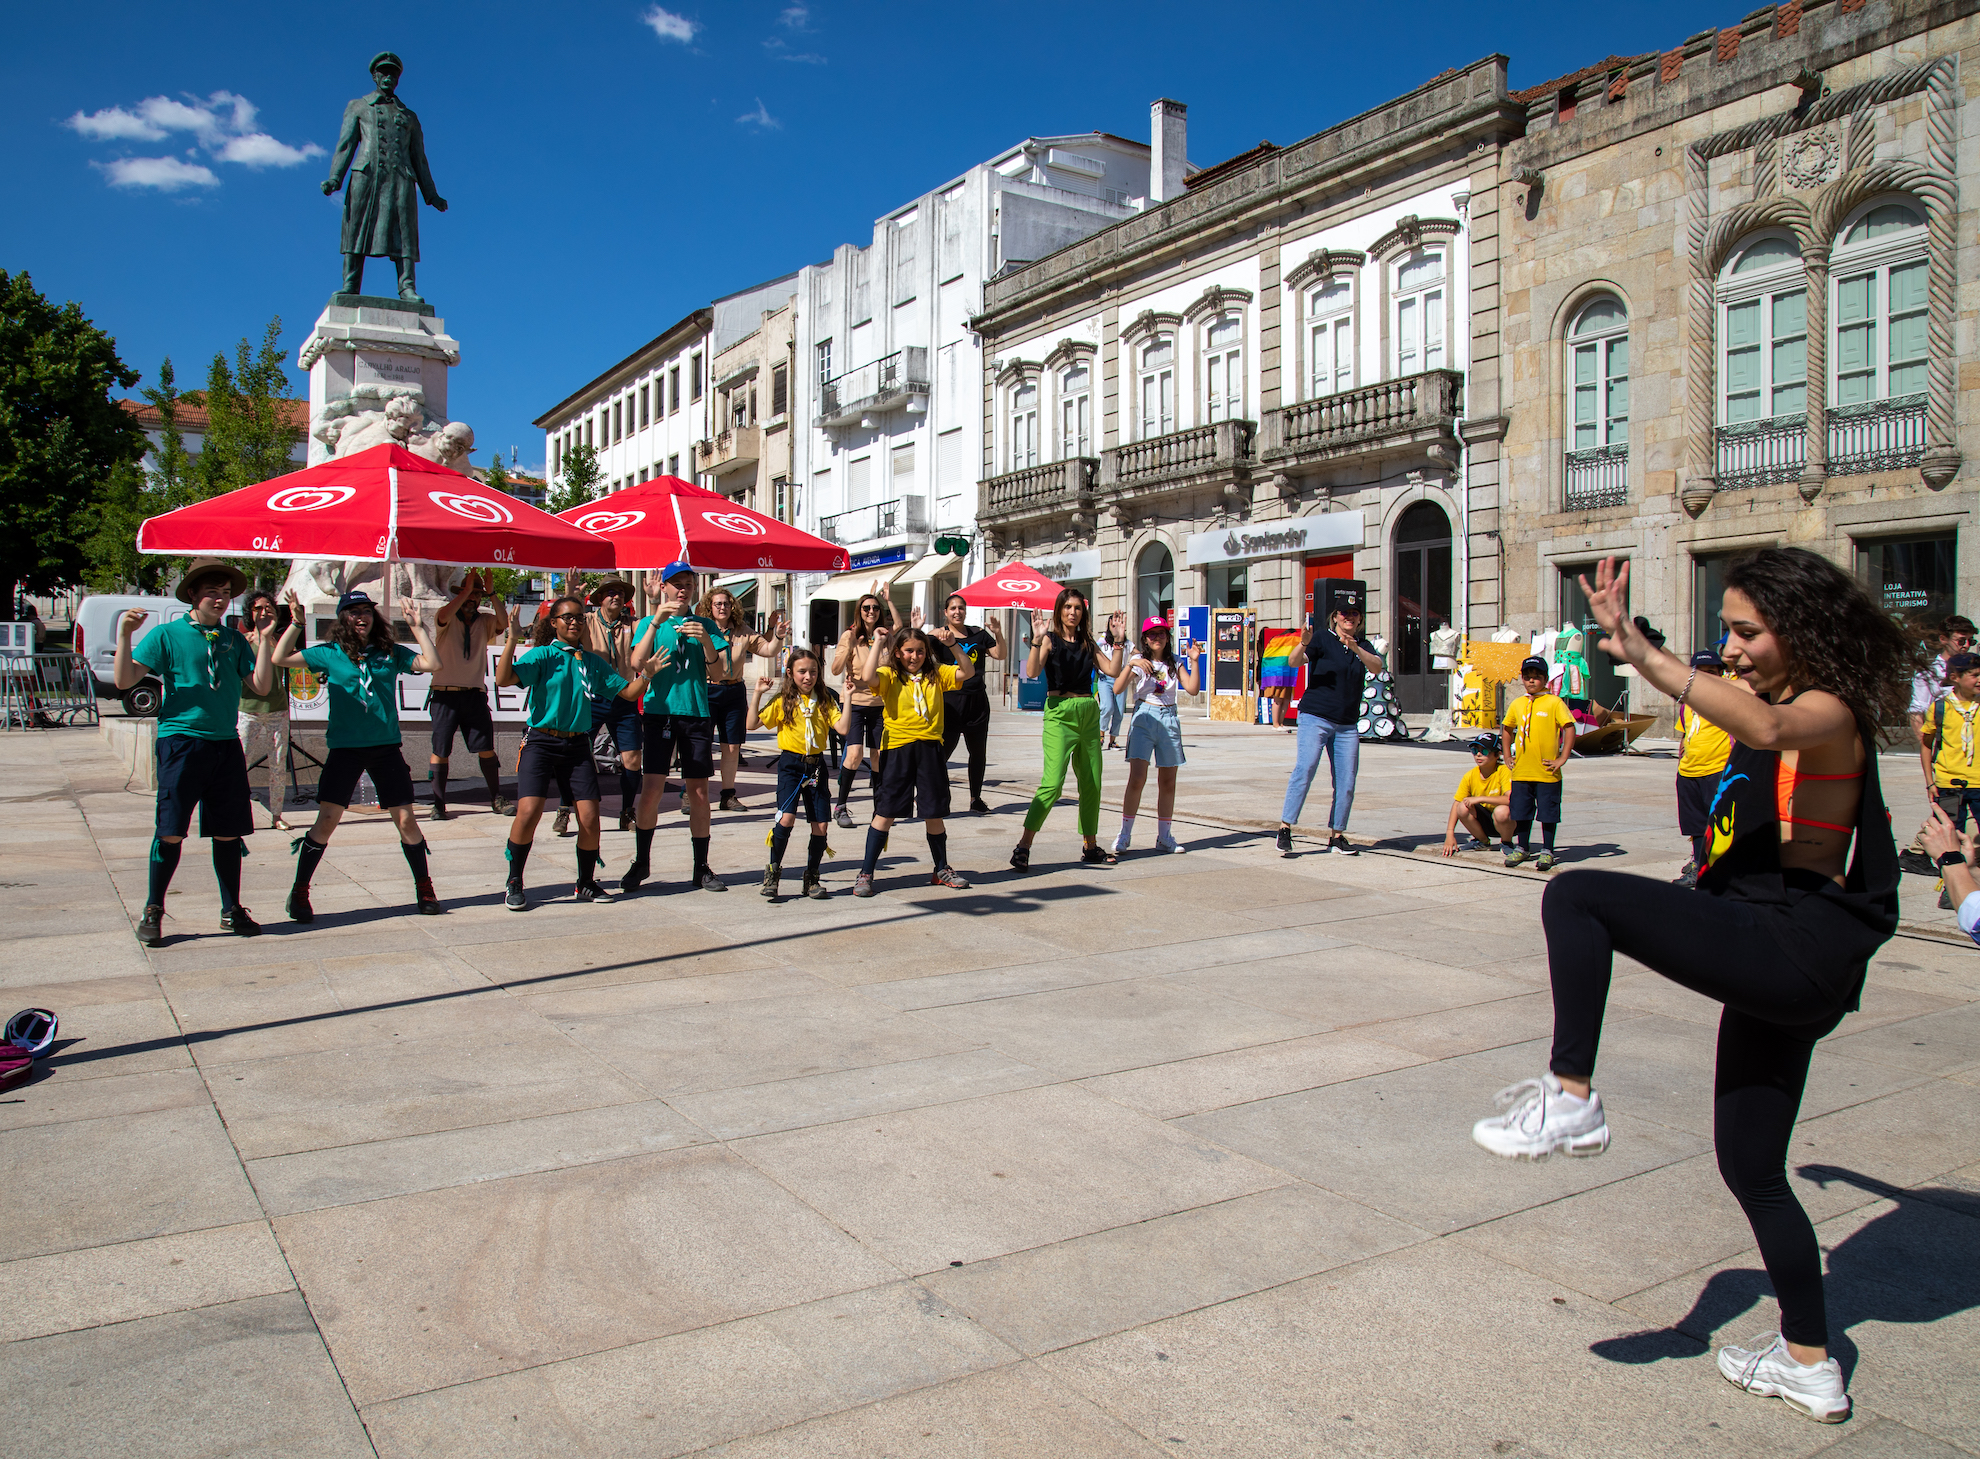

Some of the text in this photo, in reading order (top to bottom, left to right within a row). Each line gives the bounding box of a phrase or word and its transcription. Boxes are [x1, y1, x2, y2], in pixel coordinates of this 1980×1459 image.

[358, 361, 393, 372] CARVALHO
[252, 535, 281, 551] OLÁ
[1241, 527, 1308, 553] Santander
[493, 546, 515, 563] OLÁ
[757, 555, 774, 568] OLÁ
[1883, 583, 1903, 591] LOJA
[1883, 590, 1928, 600] INTERATIVA
[1011, 600, 1026, 608] OLÁ
[1883, 599, 1929, 609] DE TURISMO
